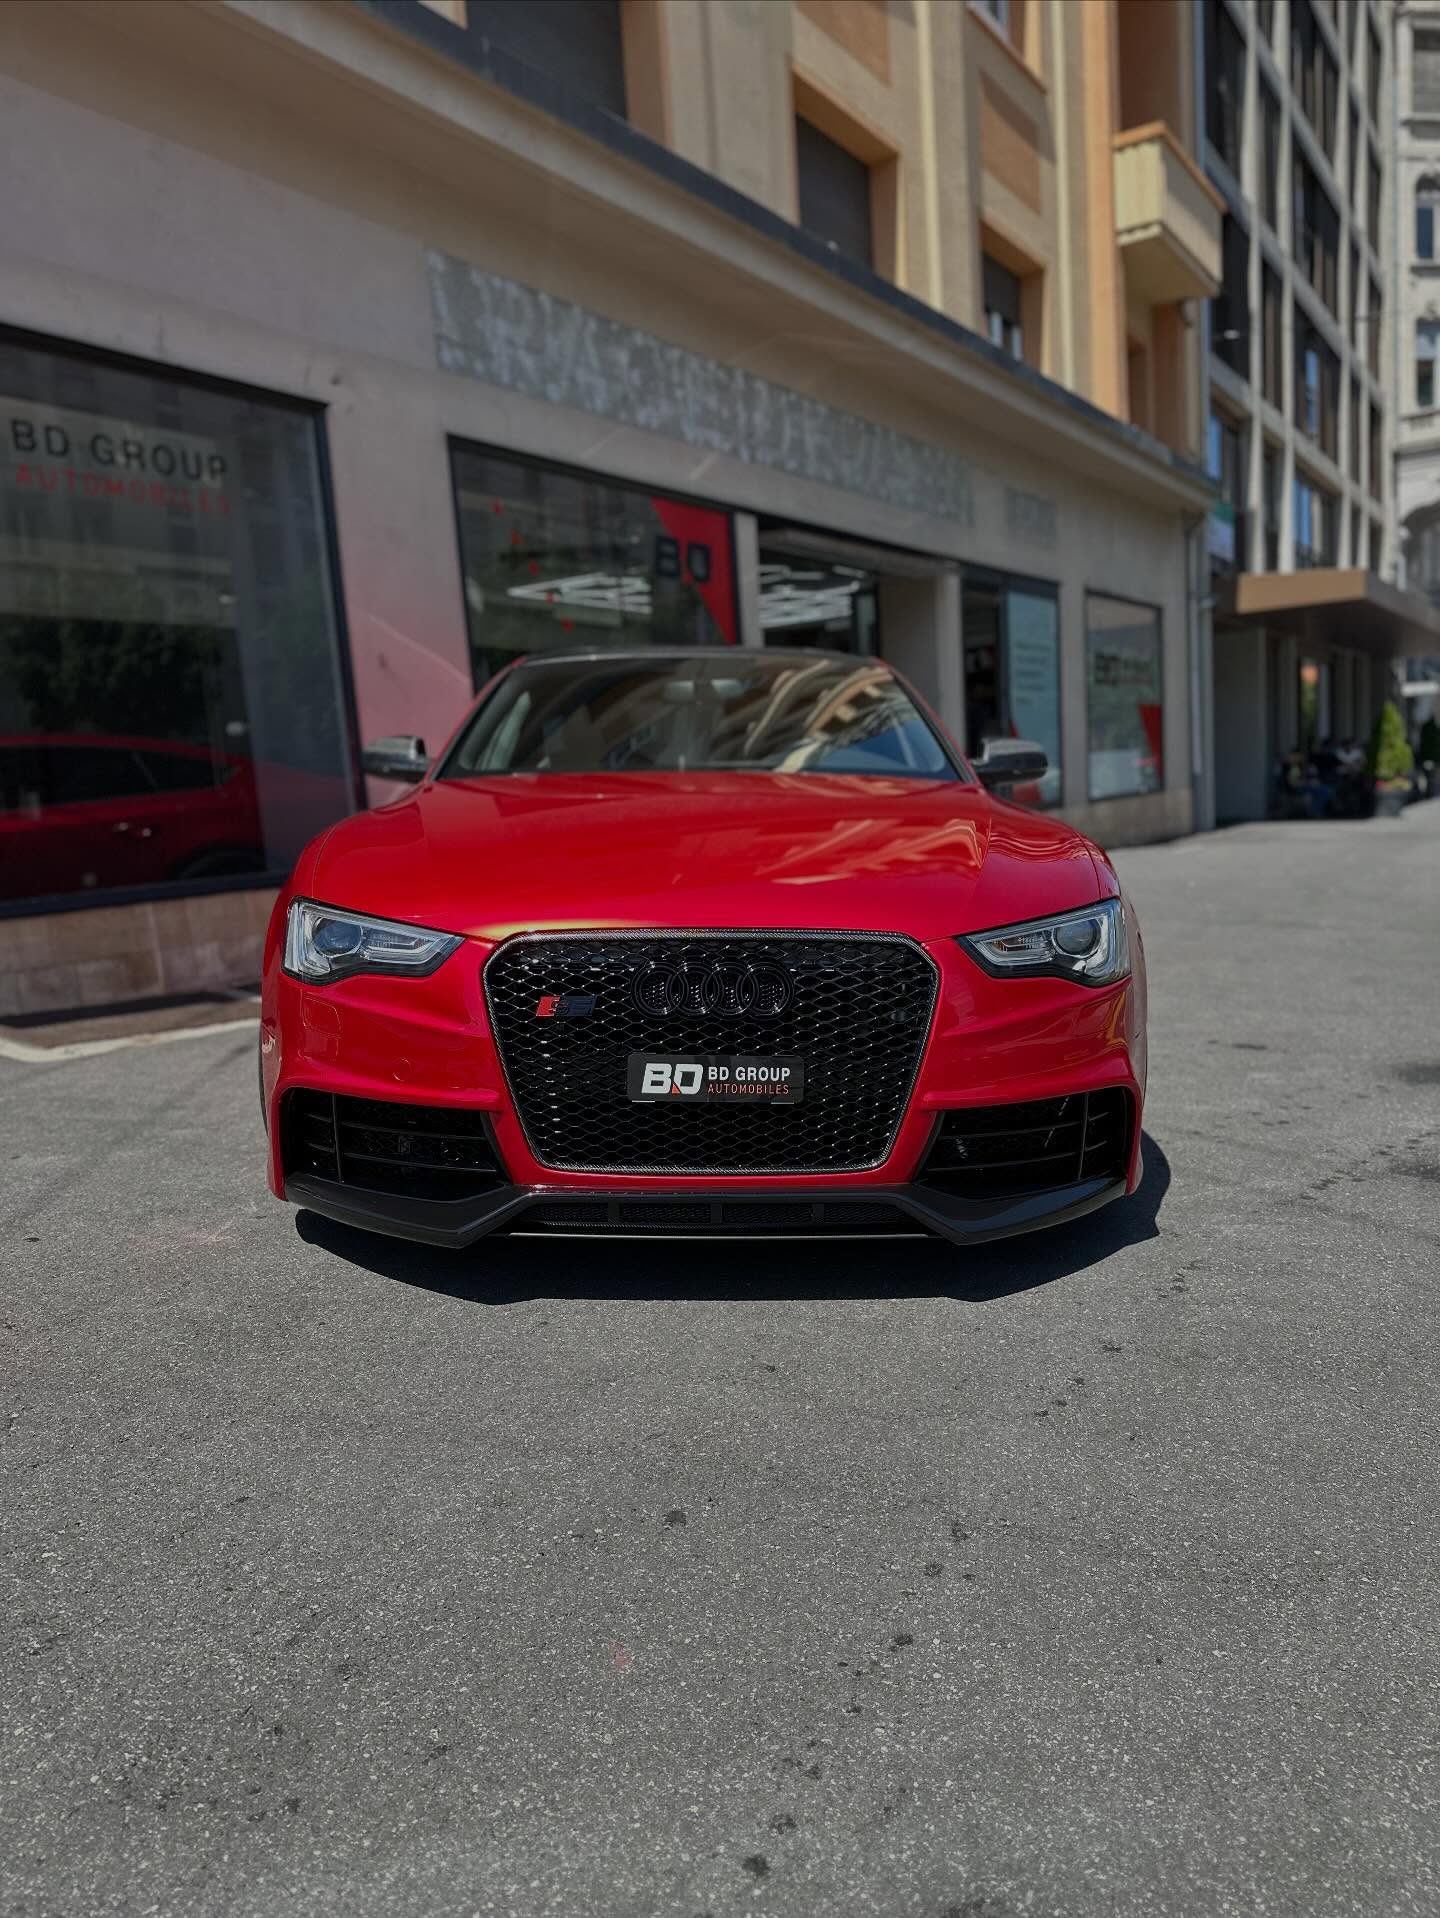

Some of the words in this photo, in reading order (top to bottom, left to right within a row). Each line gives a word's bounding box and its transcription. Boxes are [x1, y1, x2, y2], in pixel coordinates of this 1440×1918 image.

[11, 418, 70, 458] BD
[90, 432, 228, 481] GROUP
[641, 1062, 704, 1095] BD
[708, 1066, 730, 1081] BD
[735, 1066, 791, 1082] GROUP
[707, 1083, 790, 1095] AUTOMOBILES
